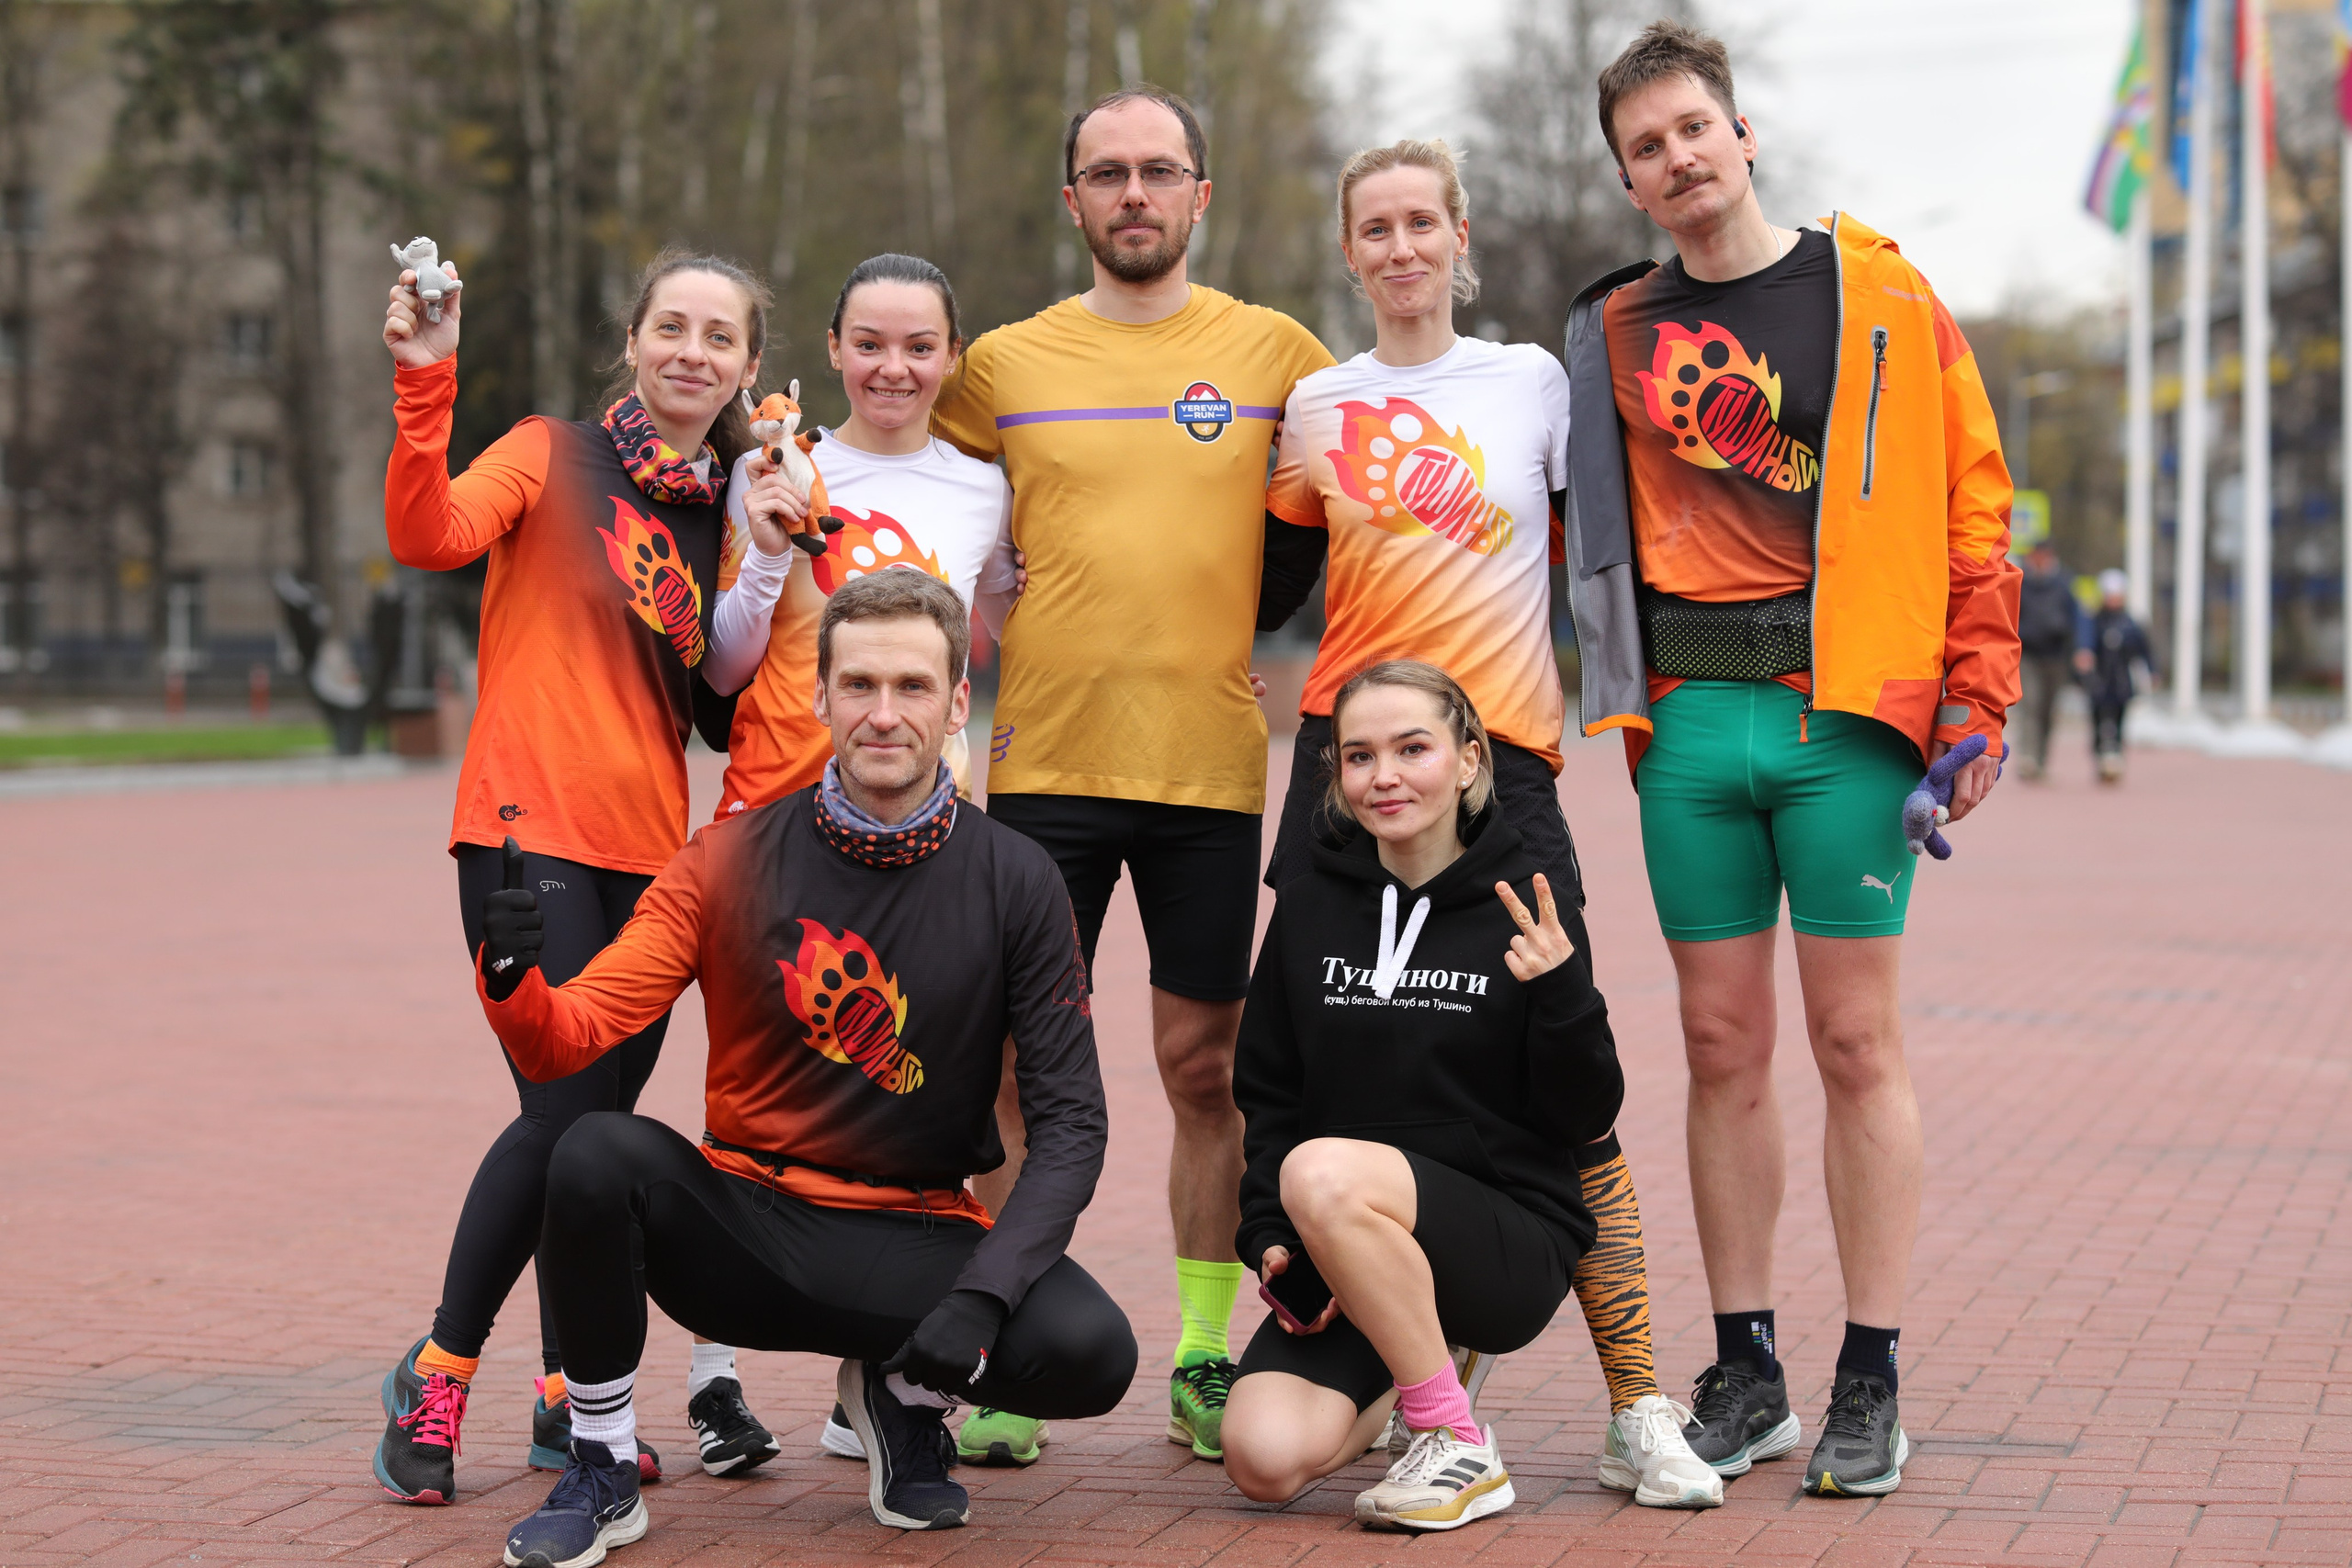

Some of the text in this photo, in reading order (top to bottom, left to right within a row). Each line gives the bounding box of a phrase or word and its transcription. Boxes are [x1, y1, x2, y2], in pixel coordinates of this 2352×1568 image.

[1180, 404, 1227, 412] YEREVAN
[1324, 994, 1350, 1007] (сущ.)
[1392, 998, 1417, 1009] клуб
[1433, 998, 1472, 1013] Тушино
